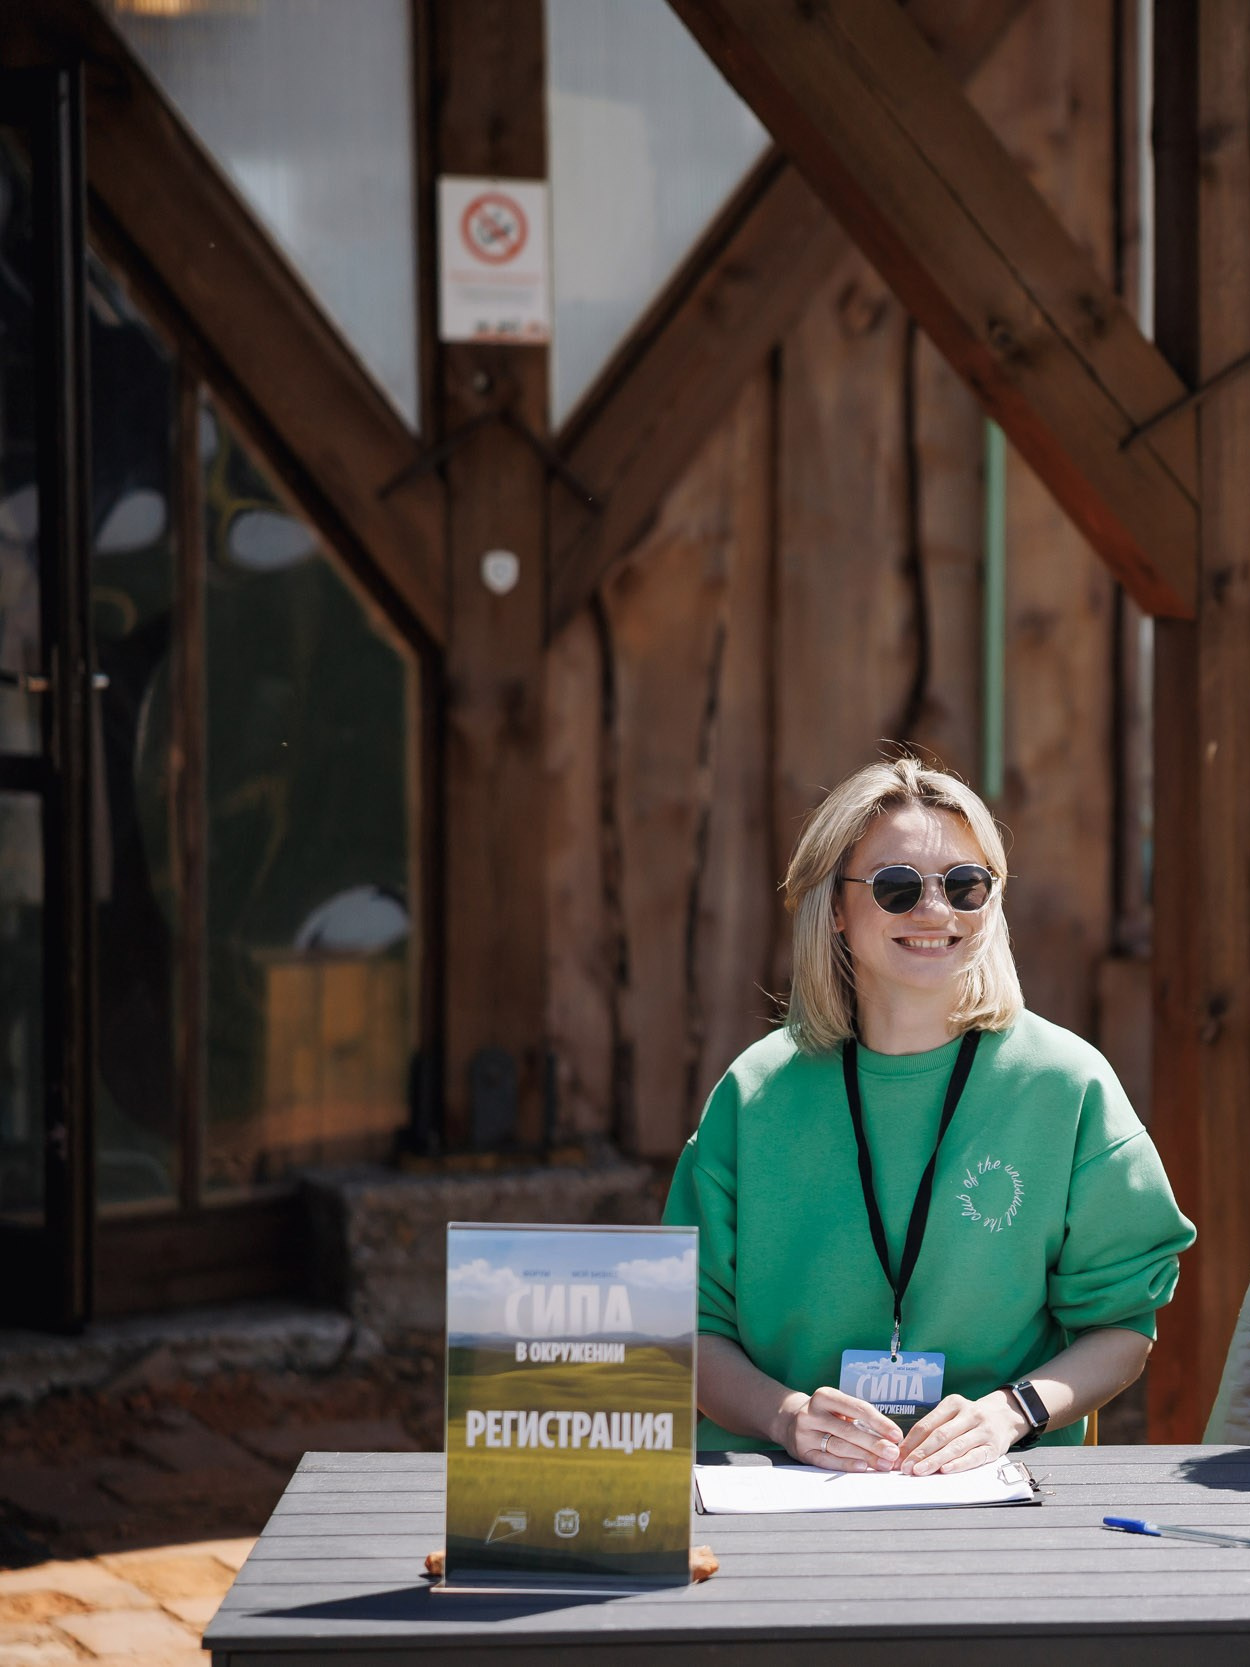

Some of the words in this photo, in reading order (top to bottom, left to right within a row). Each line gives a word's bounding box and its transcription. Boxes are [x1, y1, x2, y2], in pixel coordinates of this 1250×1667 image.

[963, 1168, 979, 1189] of
[978, 1155, 1001, 1174] the
[1004, 1164, 1025, 1226] unusual
[515, 1341, 528, 1363] В
[529, 1342, 625, 1363] ОКРУЖЕНИИ
[872, 1404, 916, 1415] КРУЖЕНИИ
[466, 1410, 674, 1454] РЕГИСТРАЦИЯ
